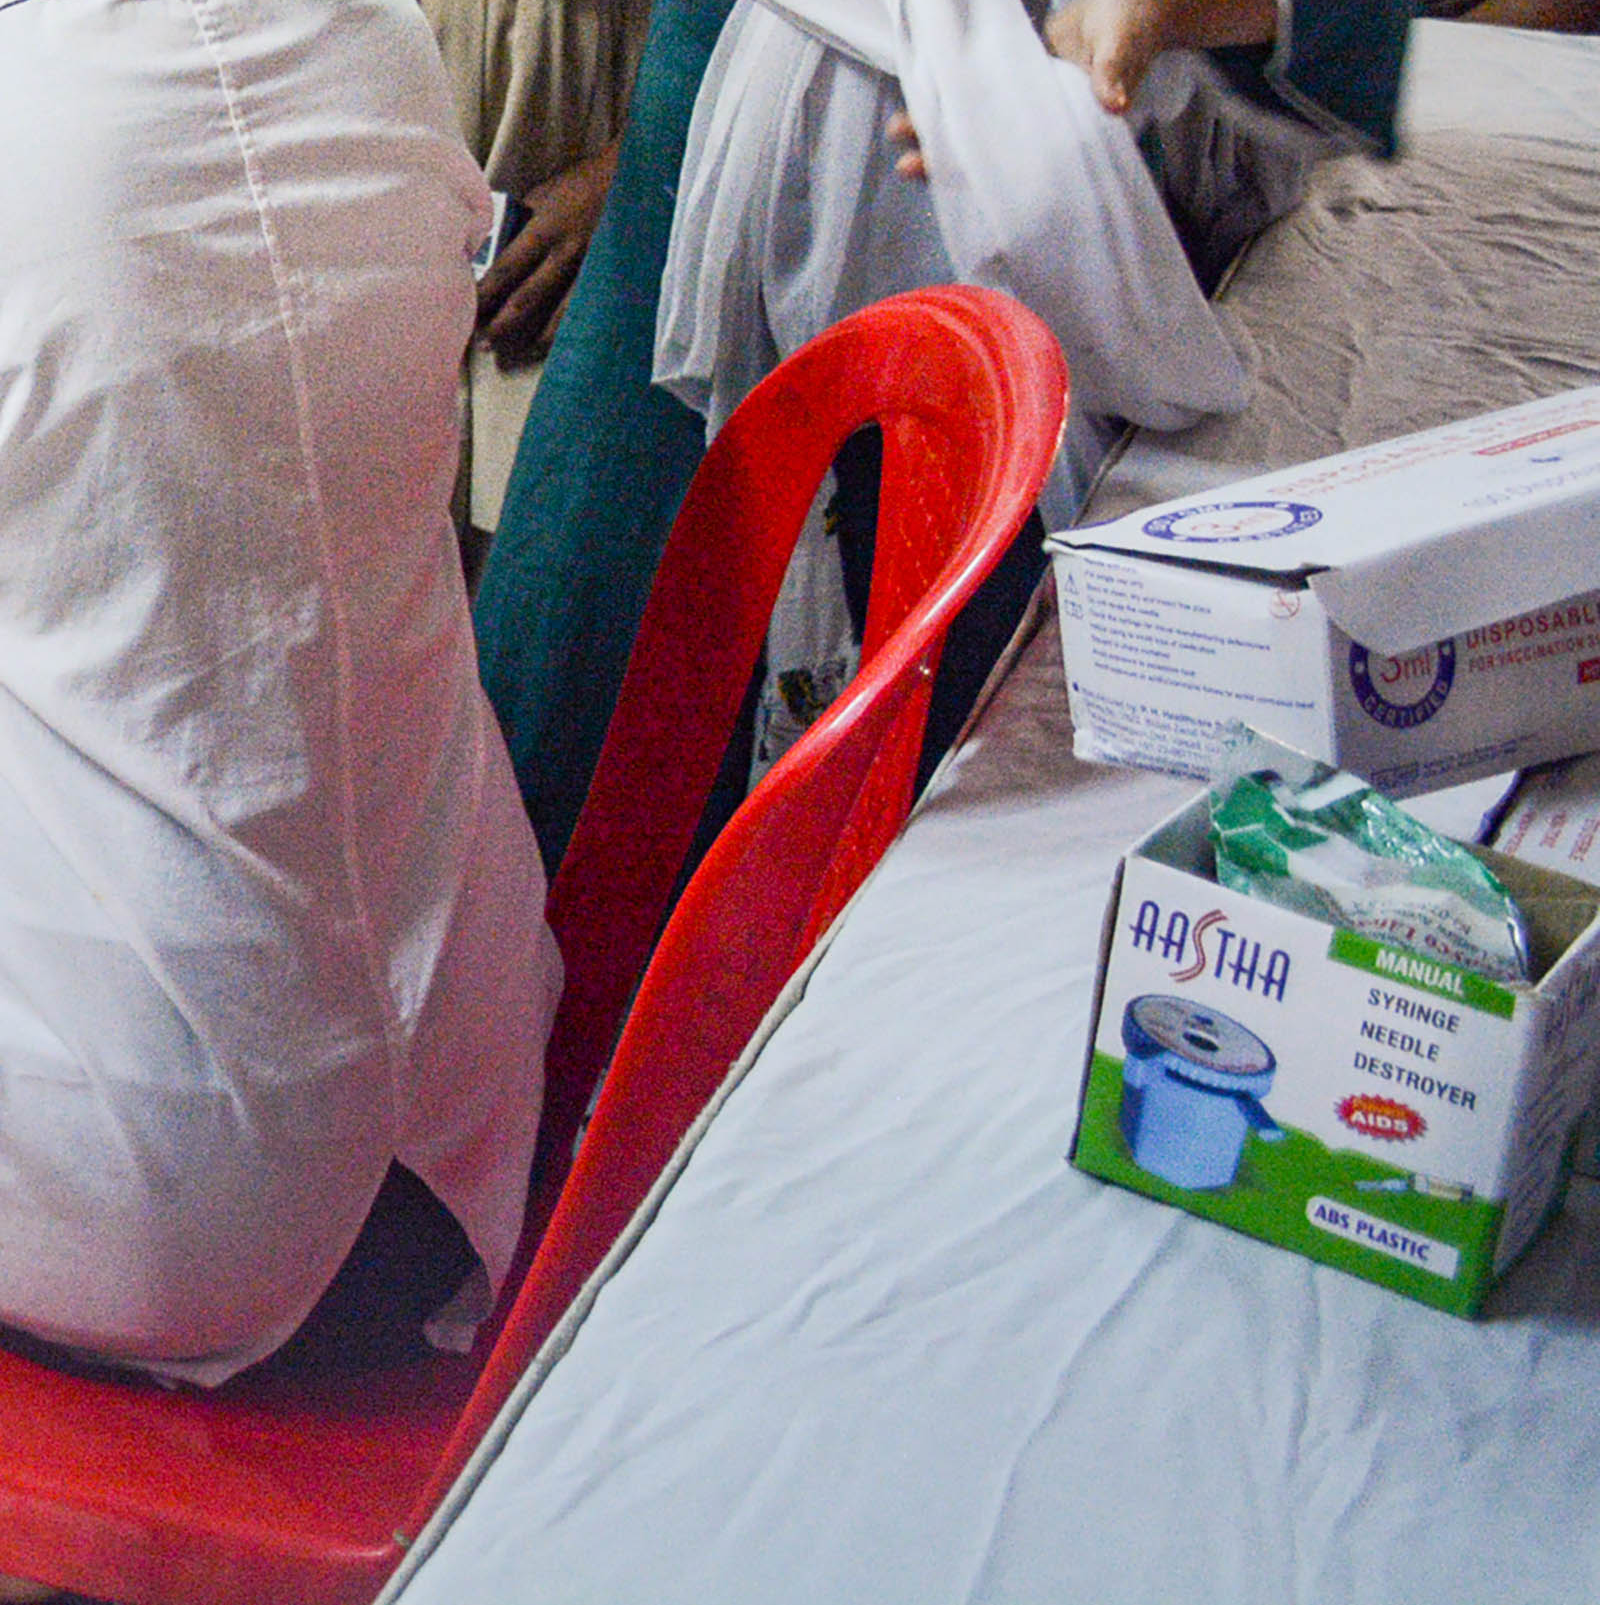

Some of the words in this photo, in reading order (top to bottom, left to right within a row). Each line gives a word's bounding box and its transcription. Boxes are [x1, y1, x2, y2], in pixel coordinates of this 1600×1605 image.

[1129, 900, 1291, 1003] AASTHA
[1375, 949, 1465, 996] MANUAL
[1367, 987, 1460, 1034] SYRINGE
[1360, 1020, 1440, 1063] NEEDLE
[1353, 1051, 1478, 1111] DESTROYER
[1351, 1110, 1409, 1133] AIDS
[1314, 1203, 1350, 1230] ABS
[1355, 1219, 1431, 1262] PLASTIC
